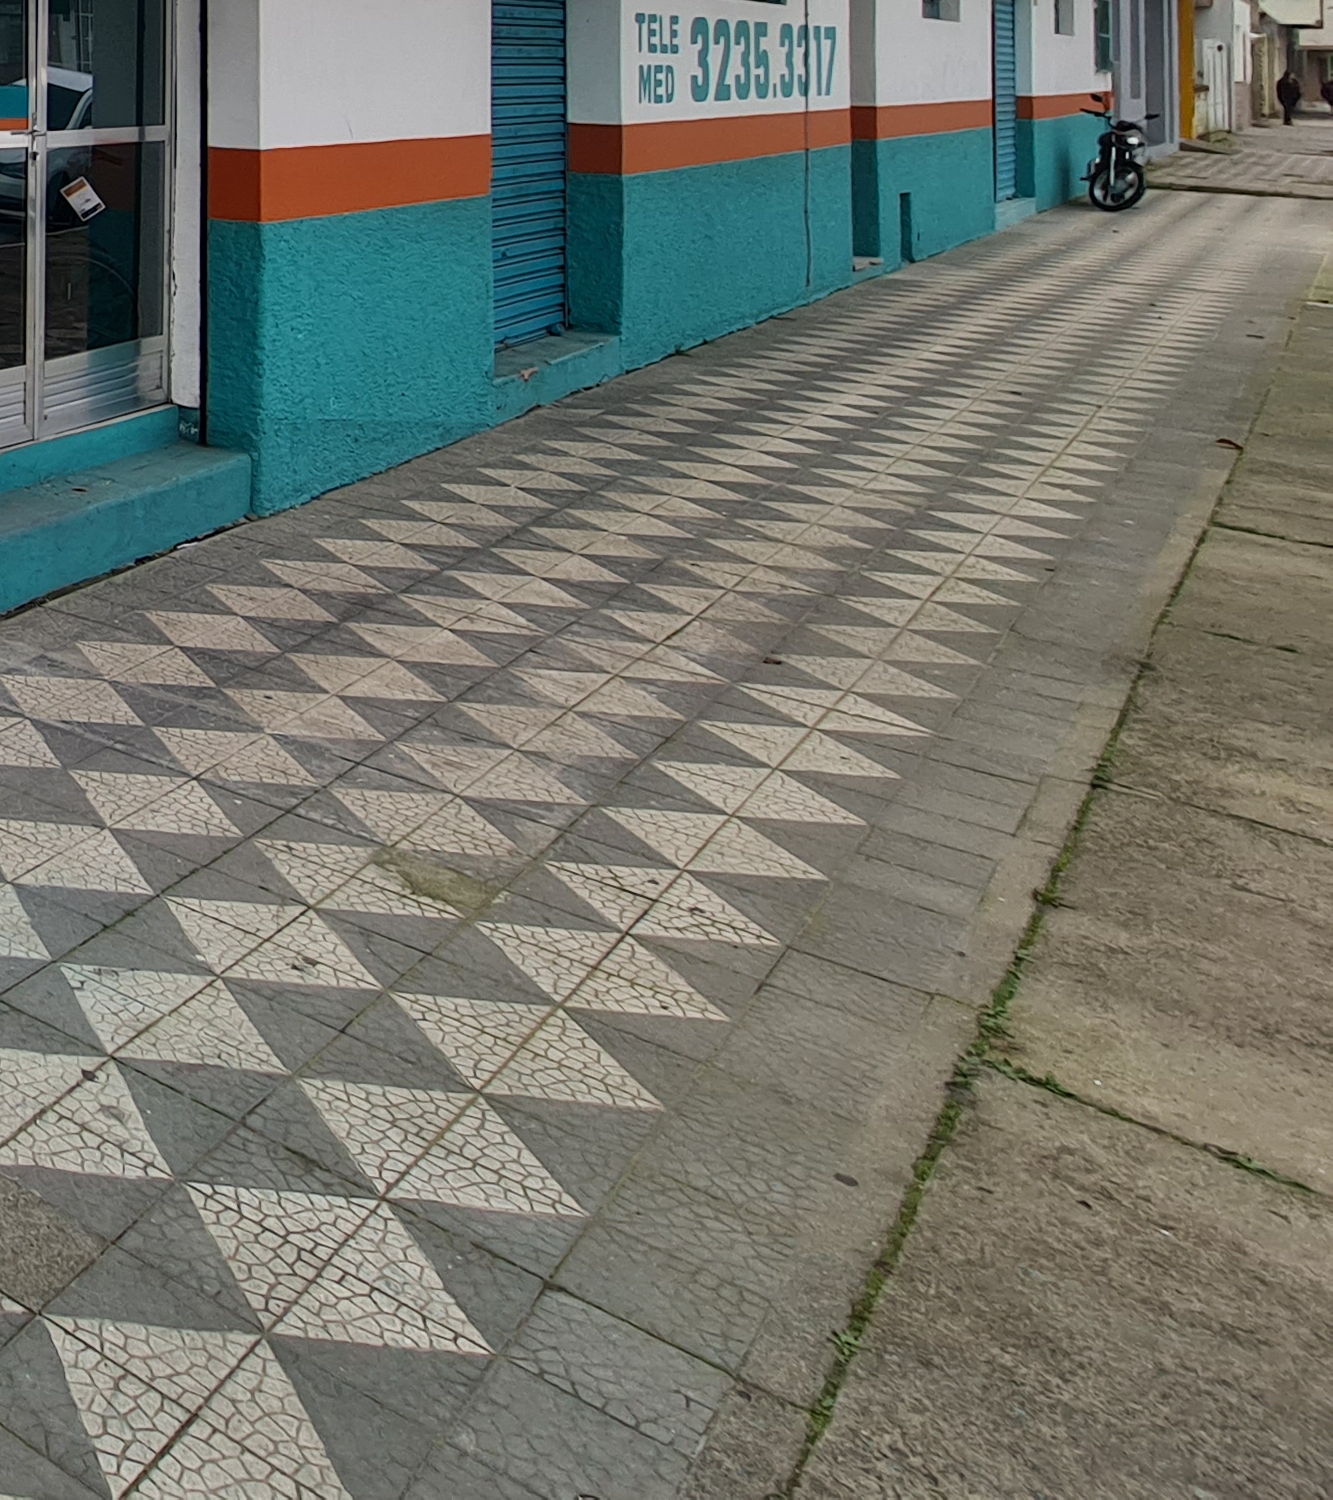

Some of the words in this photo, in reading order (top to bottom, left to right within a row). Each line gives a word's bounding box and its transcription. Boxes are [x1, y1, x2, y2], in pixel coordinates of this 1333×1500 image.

[634, 12, 680, 55] TELE
[689, 16, 837, 103] 3235.3317
[638, 64, 675, 105] MED
